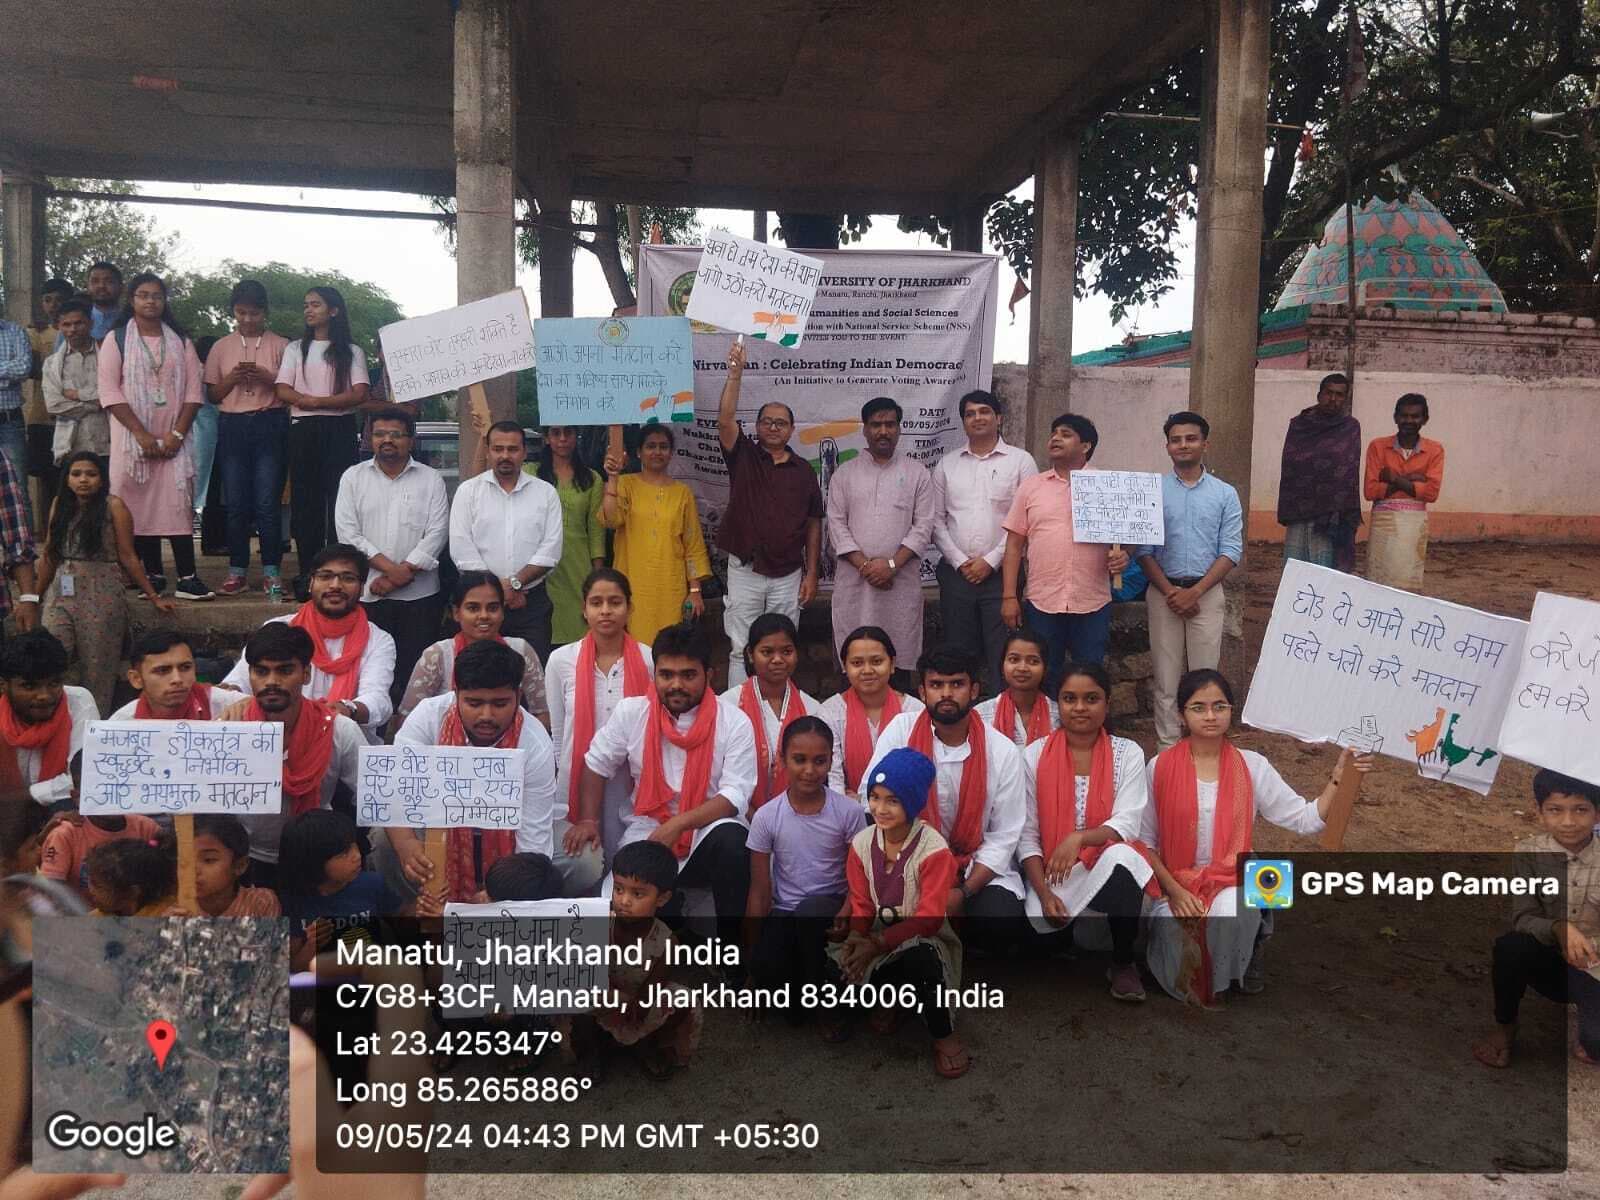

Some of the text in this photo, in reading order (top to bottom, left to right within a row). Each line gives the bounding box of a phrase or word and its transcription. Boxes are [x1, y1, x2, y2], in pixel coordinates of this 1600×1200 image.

[760, 249, 780, 275] देश
[781, 257, 799, 280] की
[818, 276, 972, 290] IVERSITY OF JHARKHAND
[809, 307, 960, 318] umanities and Social Sciences
[826, 321, 845, 331] with
[845, 322, 880, 331] National
[881, 322, 911, 331] Service
[830, 333, 848, 342] YOU
[850, 333, 861, 342] TO
[770, 358, 847, 372] Celebrating
[850, 358, 893, 370] Indian
[793, 375, 834, 385] Initiative
[836, 376, 845, 385] to
[847, 375, 889, 385] Generate
[891, 375, 920, 387] Voting
[683, 428, 720, 440] Nukka
[698, 441, 721, 452] Cha
[677, 448, 727, 465] Ghar-Gh
[1332, 592, 1353, 627] दो
[1357, 607, 1403, 641] अपने
[1411, 615, 1447, 651] सारे
[1454, 632, 1508, 668] काम
[1282, 631, 1322, 664] पहले
[1327, 644, 1364, 676] चलो
[1412, 668, 1482, 706] मतदान
[1518, 682, 1551, 709] हम
[251, 722, 281, 753] की
[366, 746, 512, 778] एक वोट का सब
[363, 774, 395, 798] पर
[443, 778, 476, 800] बस
[484, 779, 521, 803] एक
[361, 793, 391, 823] वोट
